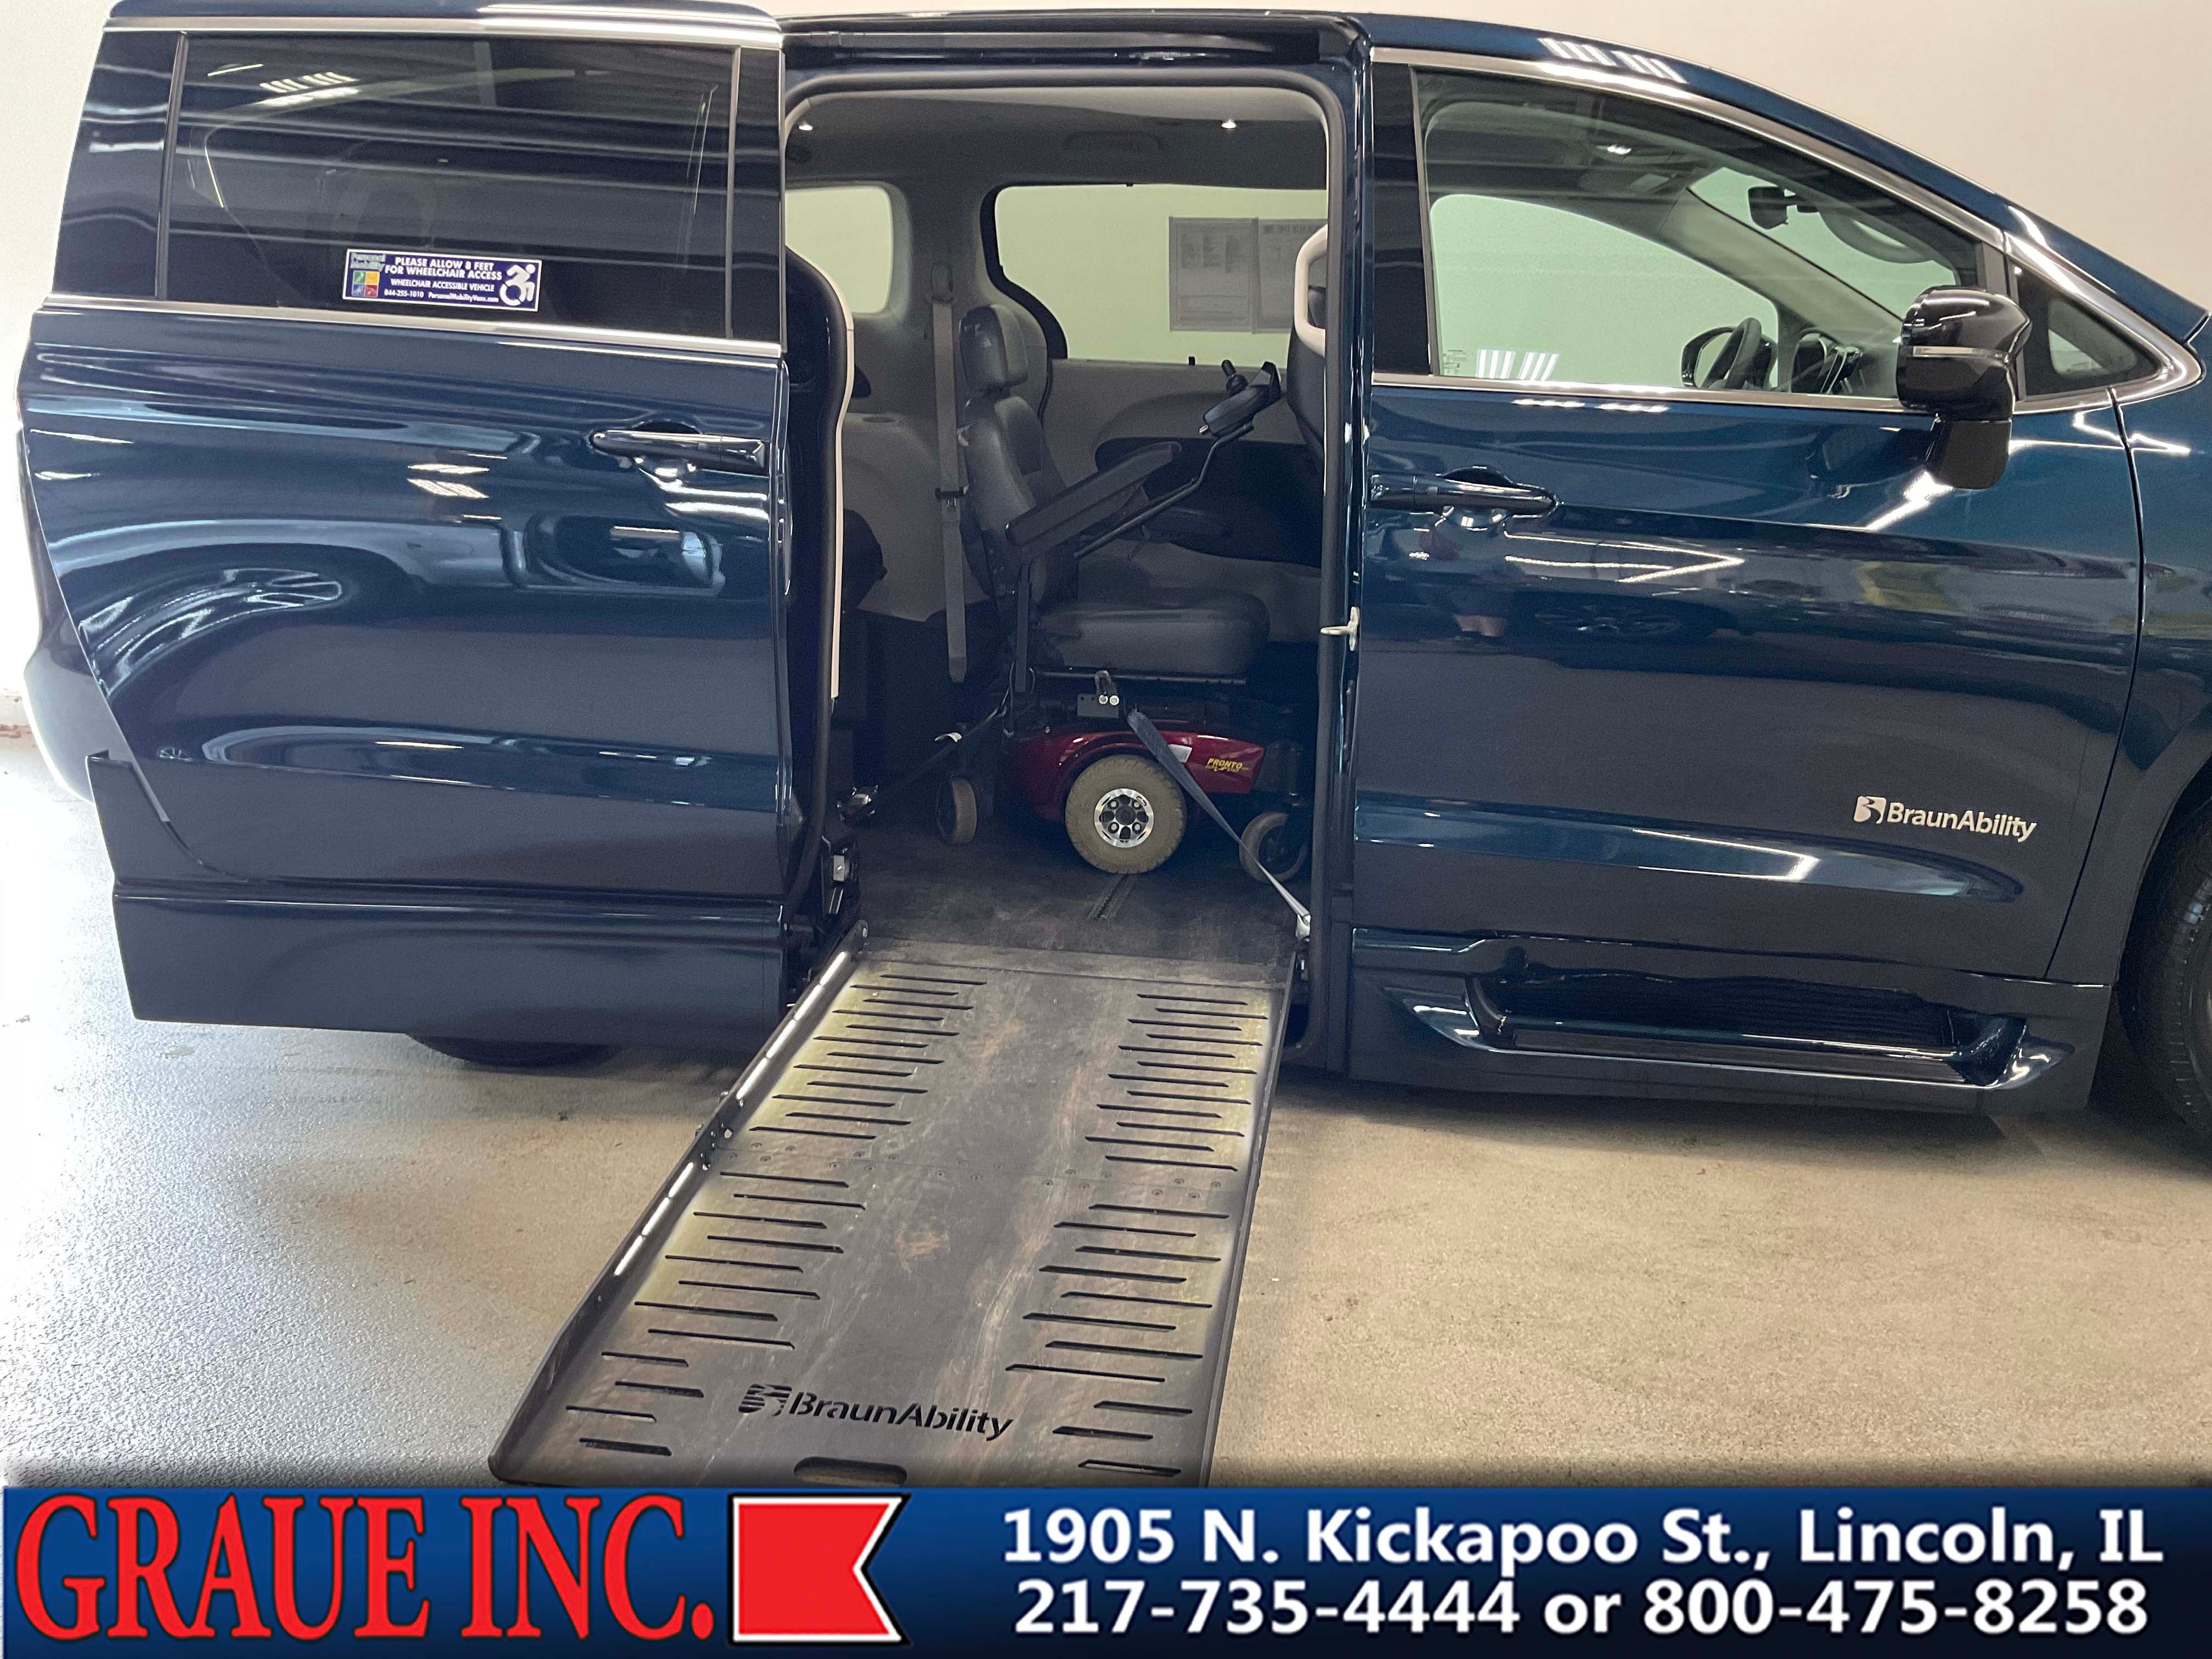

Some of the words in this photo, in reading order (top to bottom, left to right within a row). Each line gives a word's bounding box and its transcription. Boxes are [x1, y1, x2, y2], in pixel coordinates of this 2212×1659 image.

[394, 257, 427, 267] PLEASE
[430, 259, 463, 269] ALLOW
[465, 261, 472, 270] 8
[474, 262, 494, 271] FEET
[385, 265, 404, 274] FOR
[406, 266, 465, 278] WHEELCHAIR
[467, 270, 503, 280] ACCESS
[391, 278, 431, 288] WHEELCHAIR
[432, 281, 468, 290] ACCESSIBLE
[469, 284, 494, 292] VEHICLE
[384, 289, 424, 298] 844-255-1010
[428, 291, 499, 302] PersonalMobilityVans.com
[1207, 758, 1243, 770] PRONTO
[1887, 802, 2036, 843] BraunAbility
[789, 1391, 1013, 1442] BraunAbility
